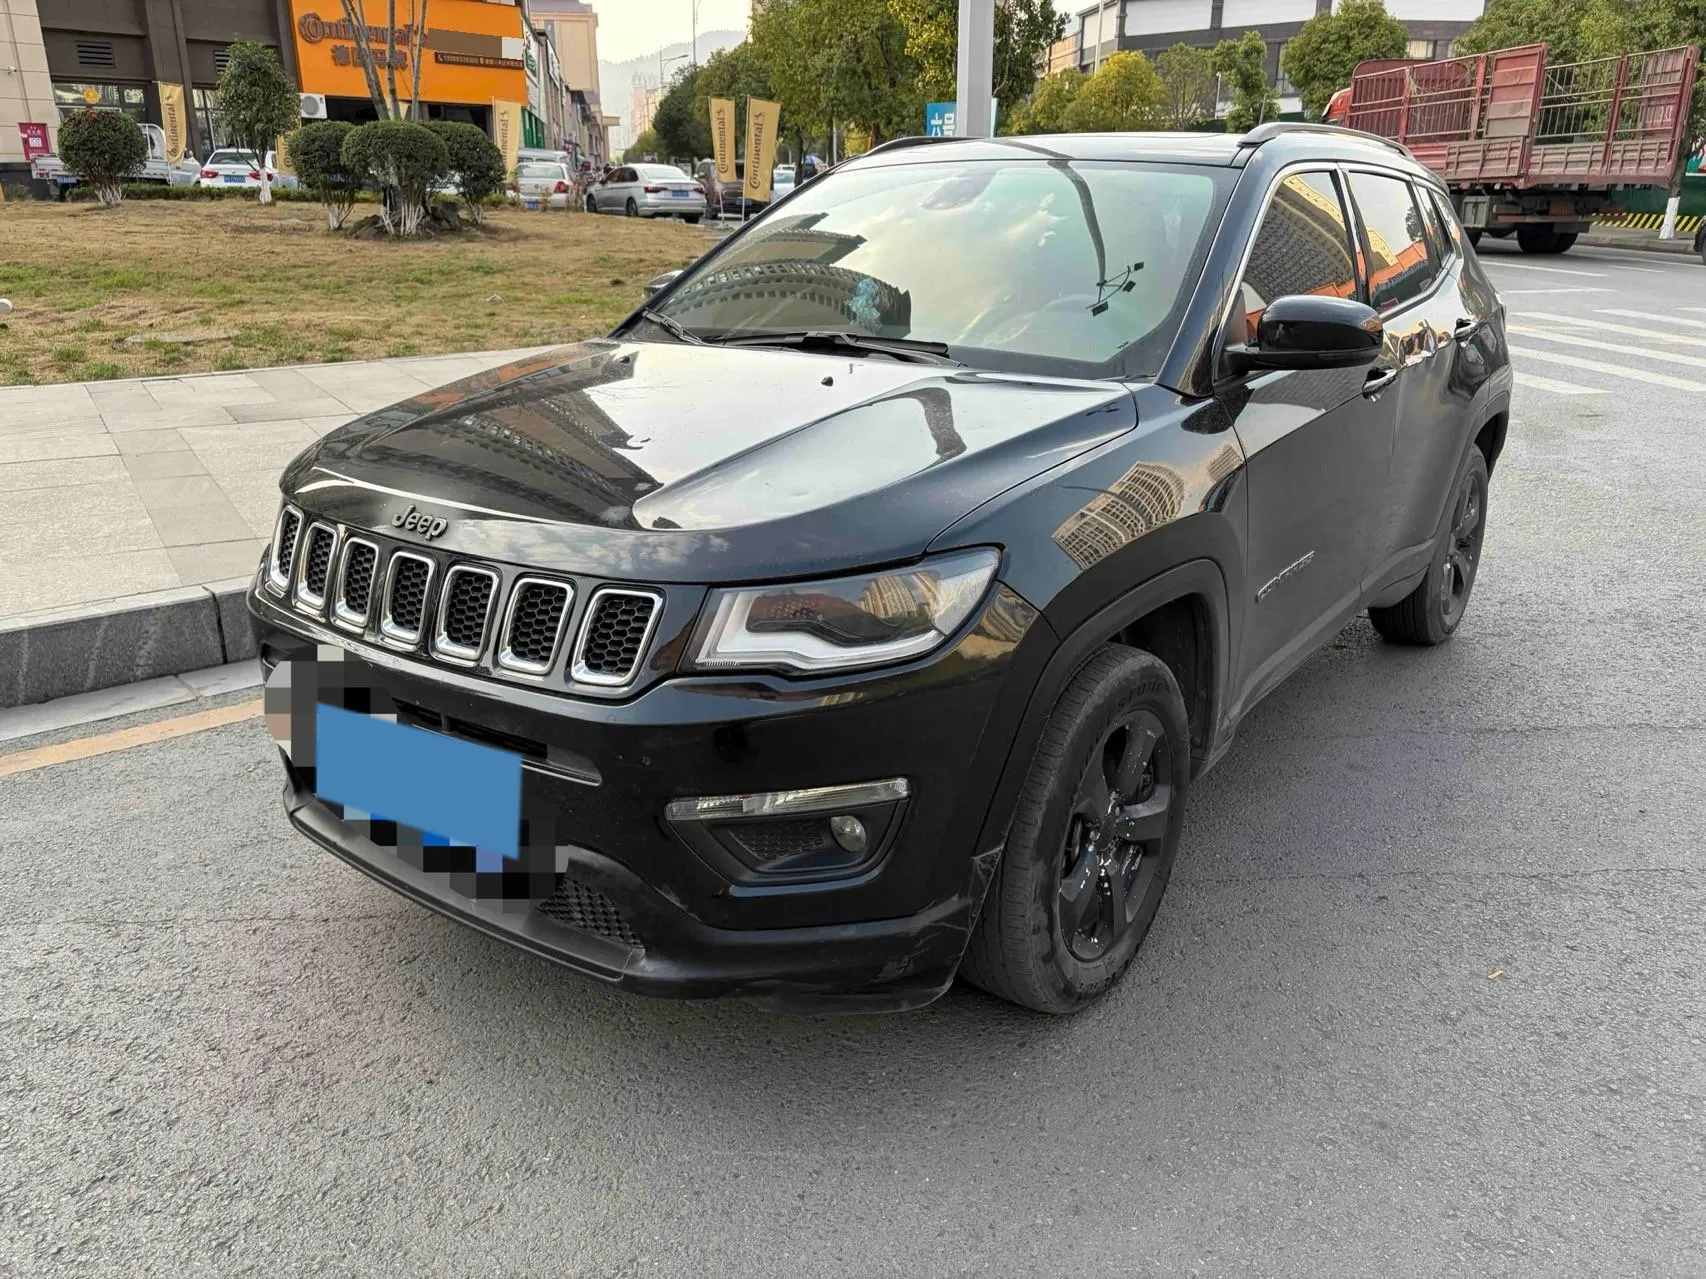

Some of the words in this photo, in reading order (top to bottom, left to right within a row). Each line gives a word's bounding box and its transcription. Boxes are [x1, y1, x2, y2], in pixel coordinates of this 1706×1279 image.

[165, 103, 180, 157] Continental
[716, 117, 729, 173] Continental
[750, 122, 764, 188] Continental
[391, 504, 448, 541] Jeep
